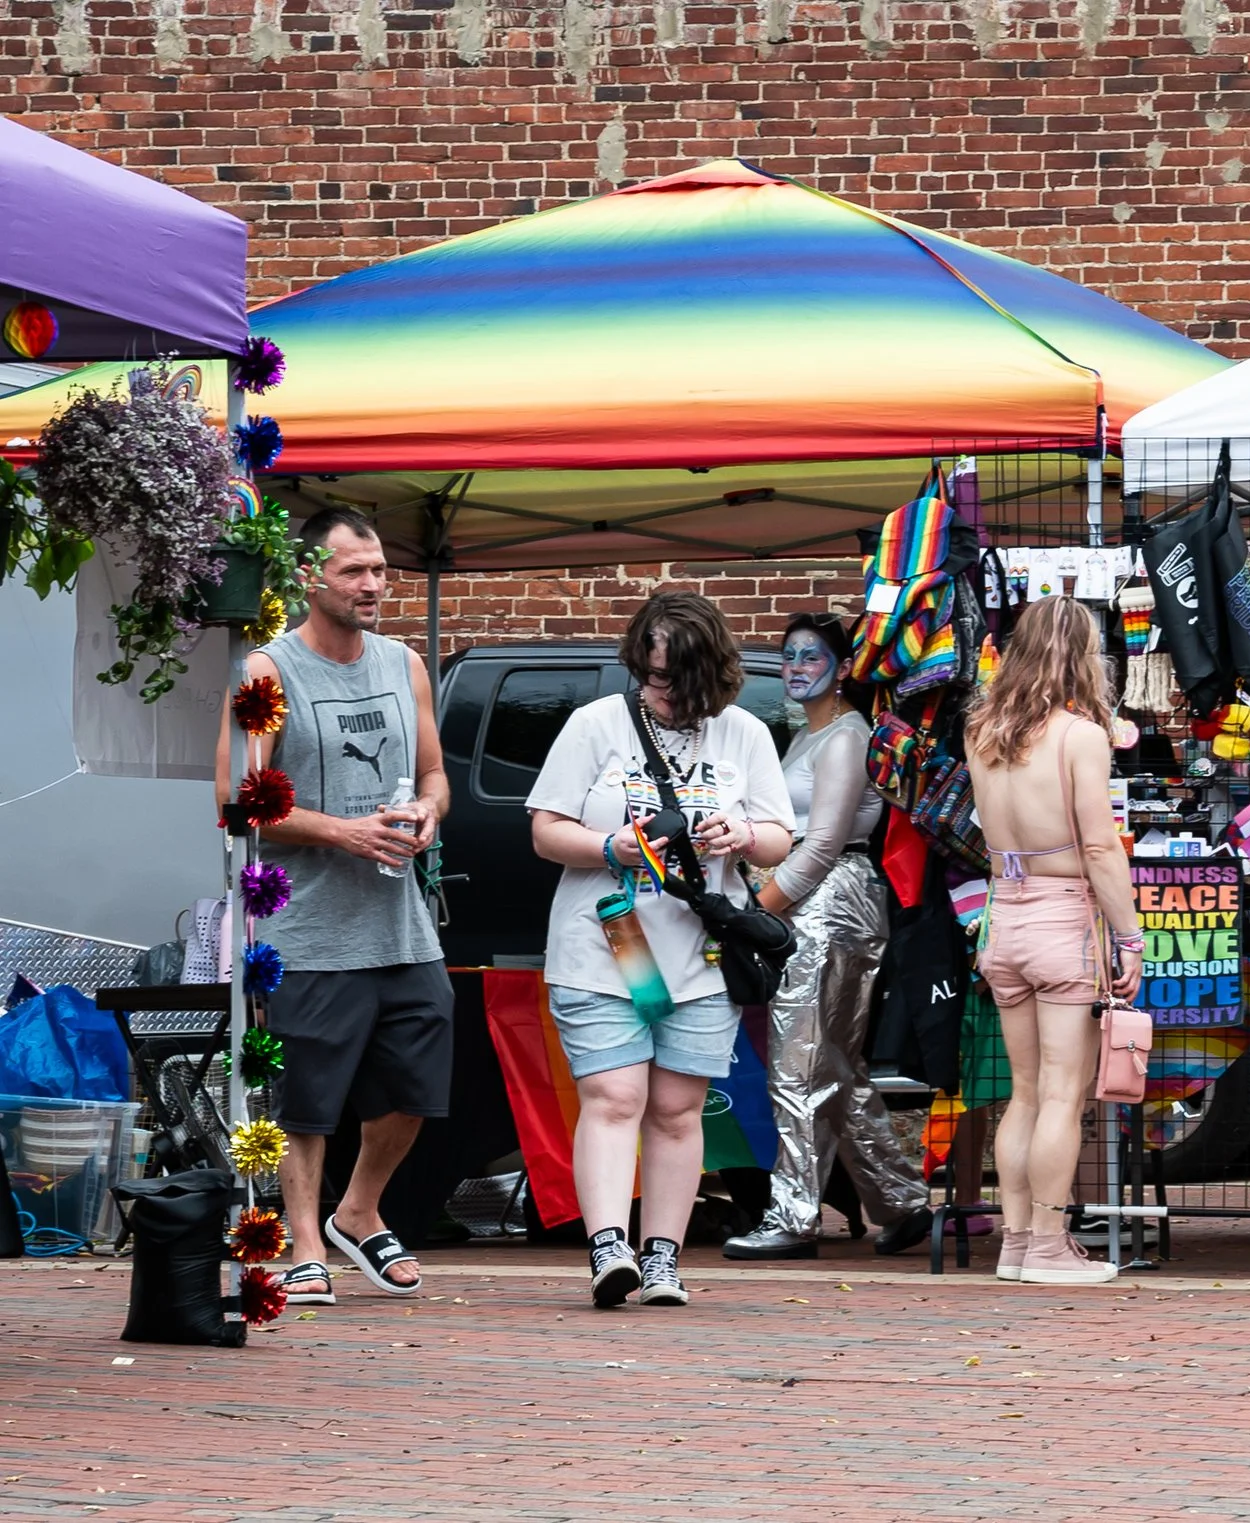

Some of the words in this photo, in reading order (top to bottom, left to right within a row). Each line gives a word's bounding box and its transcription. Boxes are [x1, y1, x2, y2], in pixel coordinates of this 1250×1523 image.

[337, 710, 386, 733] PUMA
[626, 782, 719, 806] GEDER
[1131, 866, 1238, 884] INDNESS
[1143, 929, 1240, 962] OVE
[1142, 959, 1239, 977] CLUSION
[1144, 1006, 1239, 1024] ERSITY
